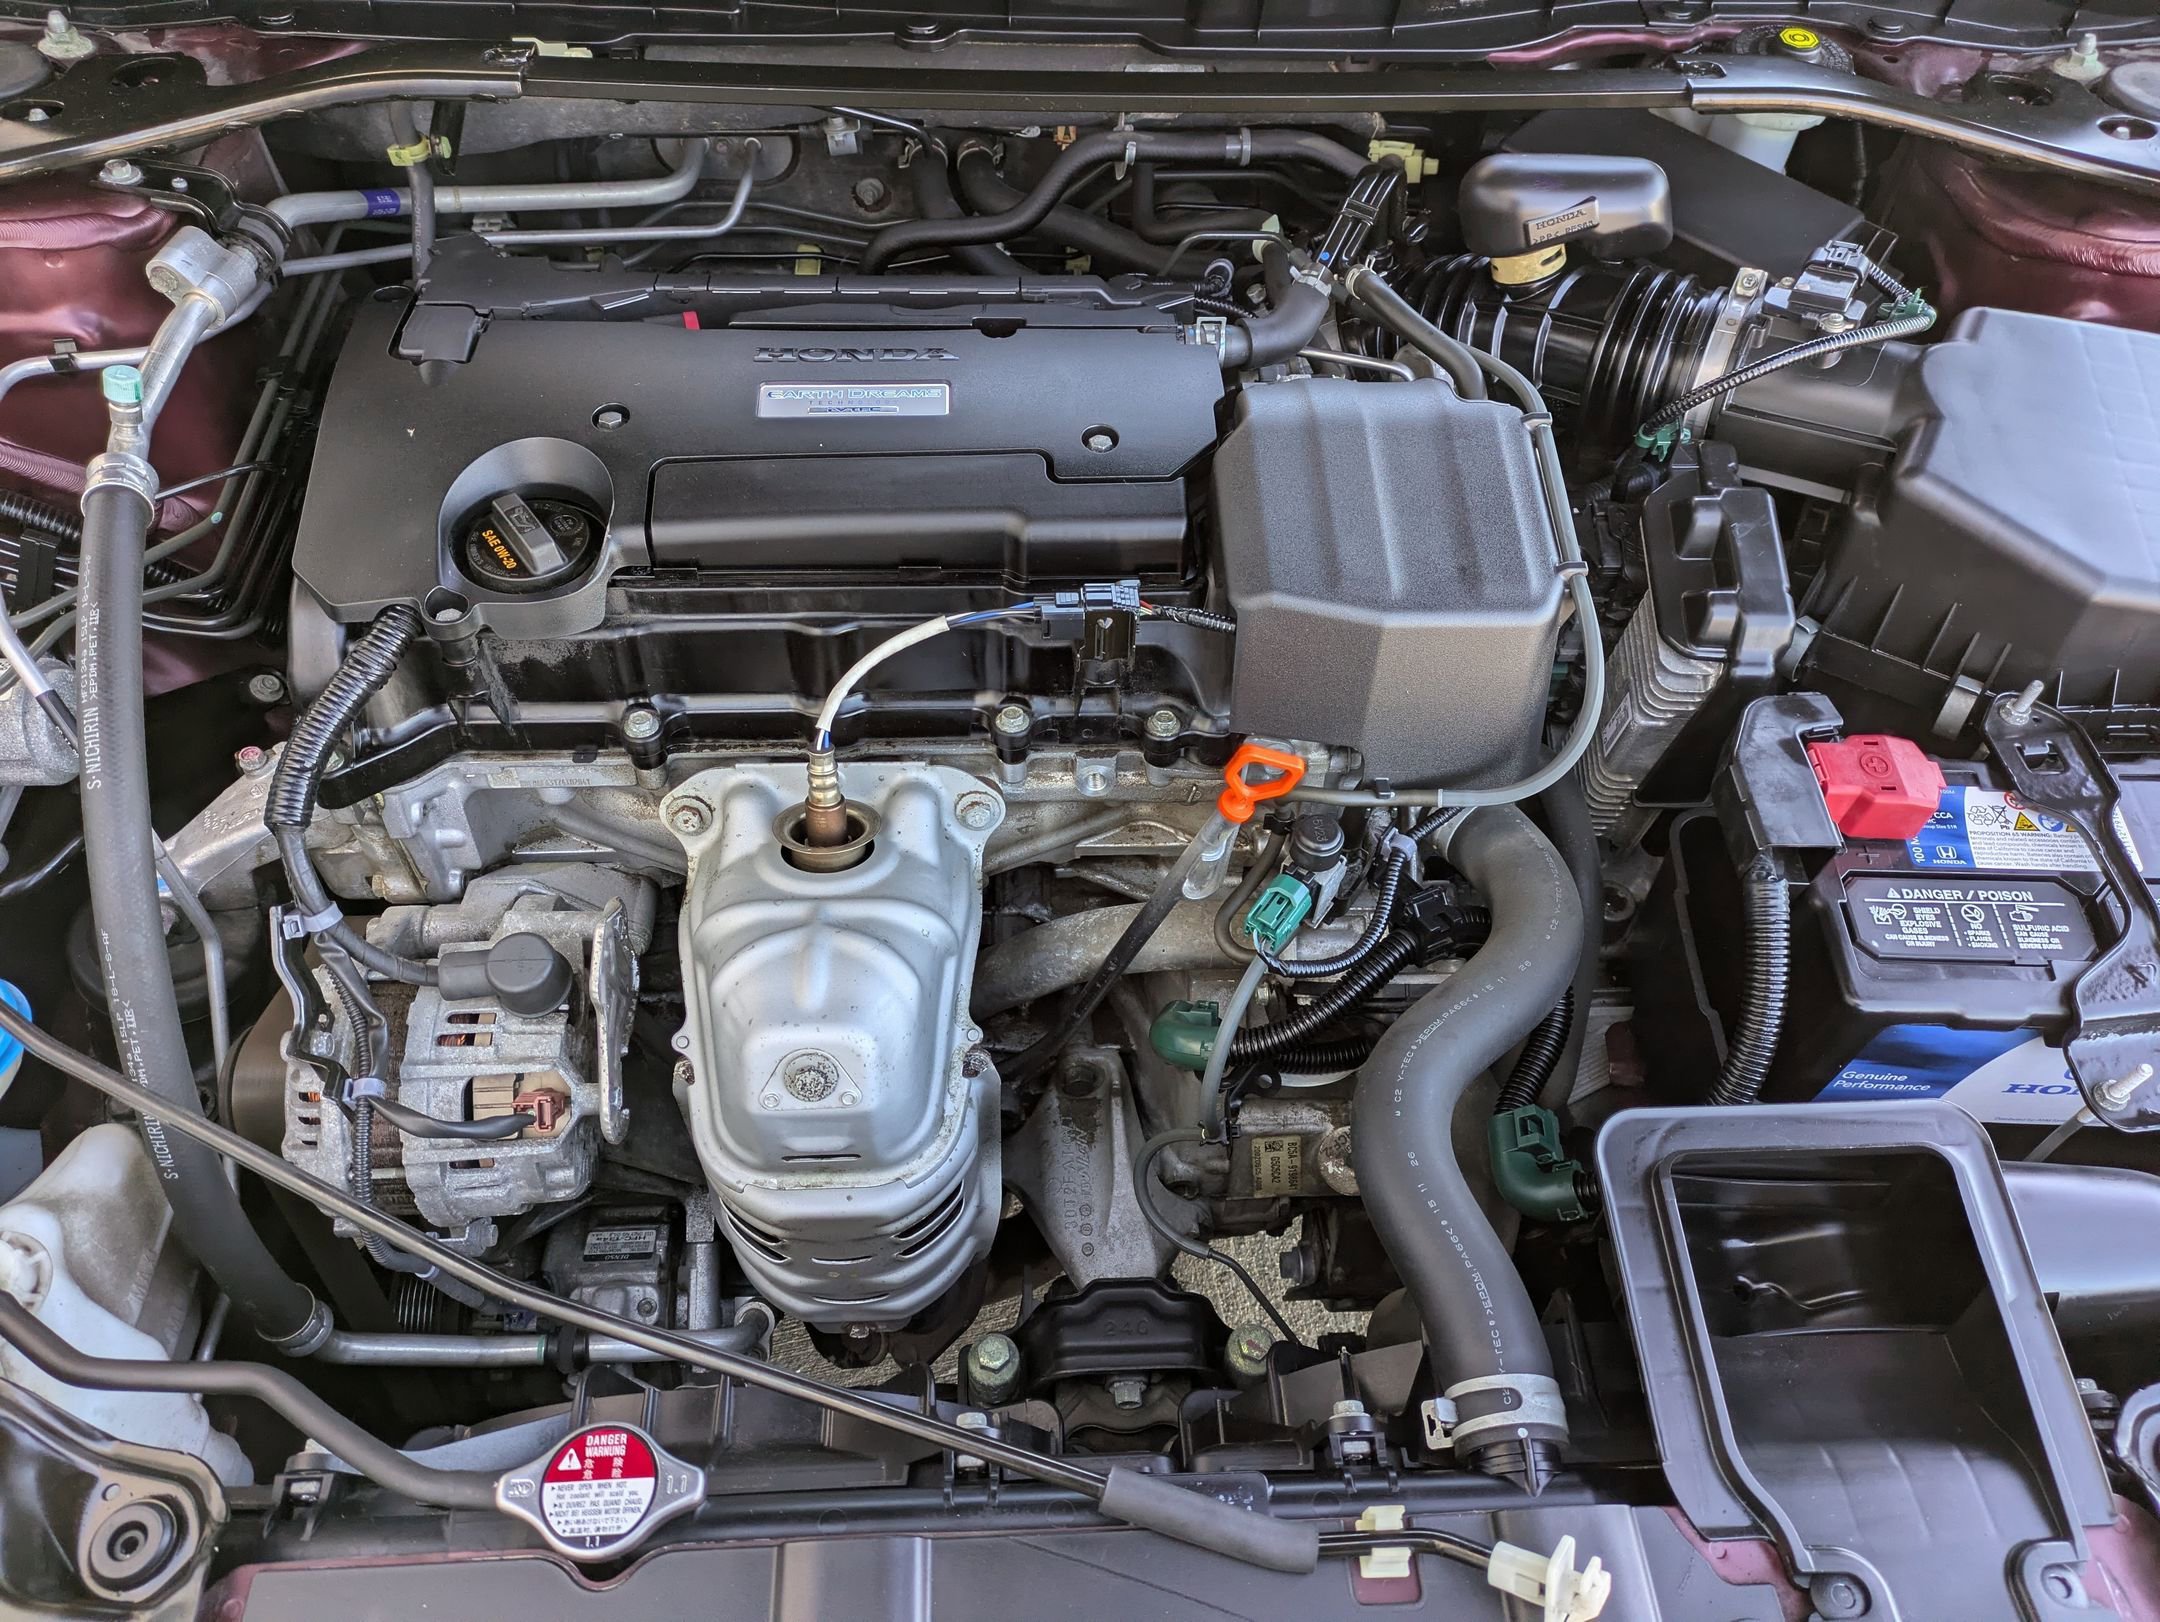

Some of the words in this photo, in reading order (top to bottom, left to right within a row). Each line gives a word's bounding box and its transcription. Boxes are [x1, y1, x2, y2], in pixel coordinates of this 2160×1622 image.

[1535, 208, 1587, 231] HONDA
[754, 347, 959, 362] HONDA
[768, 389, 843, 399] EARTH
[848, 388, 941, 399] DREAMS
[482, 529, 501, 548] SAE
[493, 543, 517, 570] 0W-20
[1933, 811, 1953, 819] CCA
[1912, 846, 1926, 863] 100
[1901, 888, 1963, 900] DANGER
[1977, 890, 2034, 901] POISON
[1899, 920, 1942, 928] EXPLOSIVE
[2012, 924, 2050, 932] SULFURIC
[1397, 1051, 1414, 1082] Y-TEC
[1841, 1071, 1908, 1082] Genuine
[1833, 1079, 1931, 1092] Performance
[1395, 1088, 1402, 1102] C2
[1491, 1329, 1506, 1374] Y-TEC
[586, 1433, 628, 1446] DANGER
[585, 1445, 626, 1458] WARNUNG
[585, 1535, 600, 1547] 1.1
